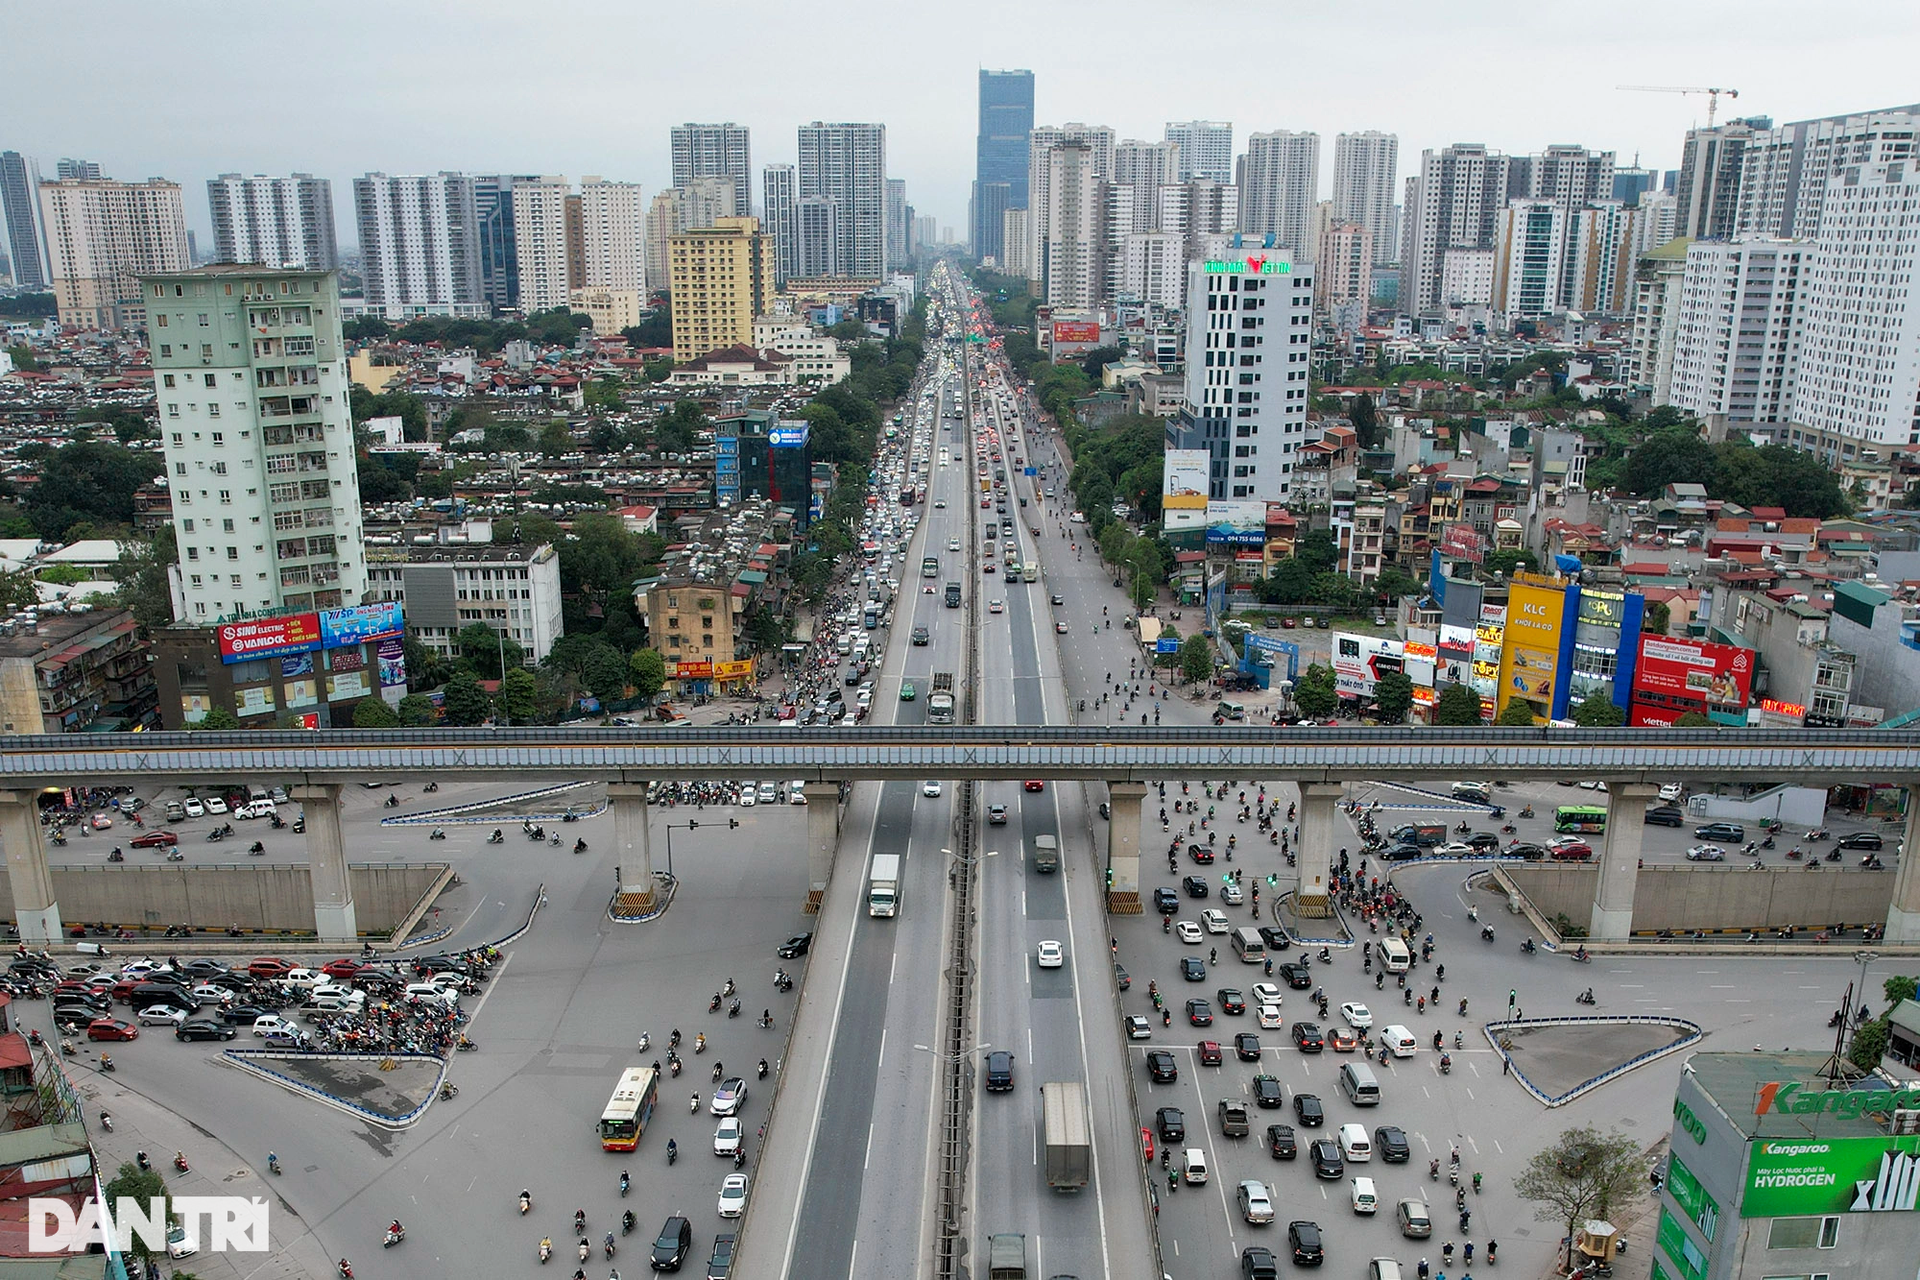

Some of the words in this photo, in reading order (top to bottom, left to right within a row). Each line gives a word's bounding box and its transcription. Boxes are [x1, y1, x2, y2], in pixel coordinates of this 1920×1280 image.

[341, 608, 353, 618] SP
[1523, 602, 1546, 616] KLC
[236, 625, 256, 637] SINO
[258, 624, 285, 634] ELECTRIC
[244, 635, 286, 648] VANLOCK
[1646, 650, 1664, 658] Website
[1642, 716, 1672, 728] viettel
[1761, 1143, 1829, 1157] Kangaroo
[1757, 1166, 1772, 1176] Máy
[1772, 1166, 1785, 1176] Lọc
[1754, 1173, 1836, 1188] HYDROGEN
